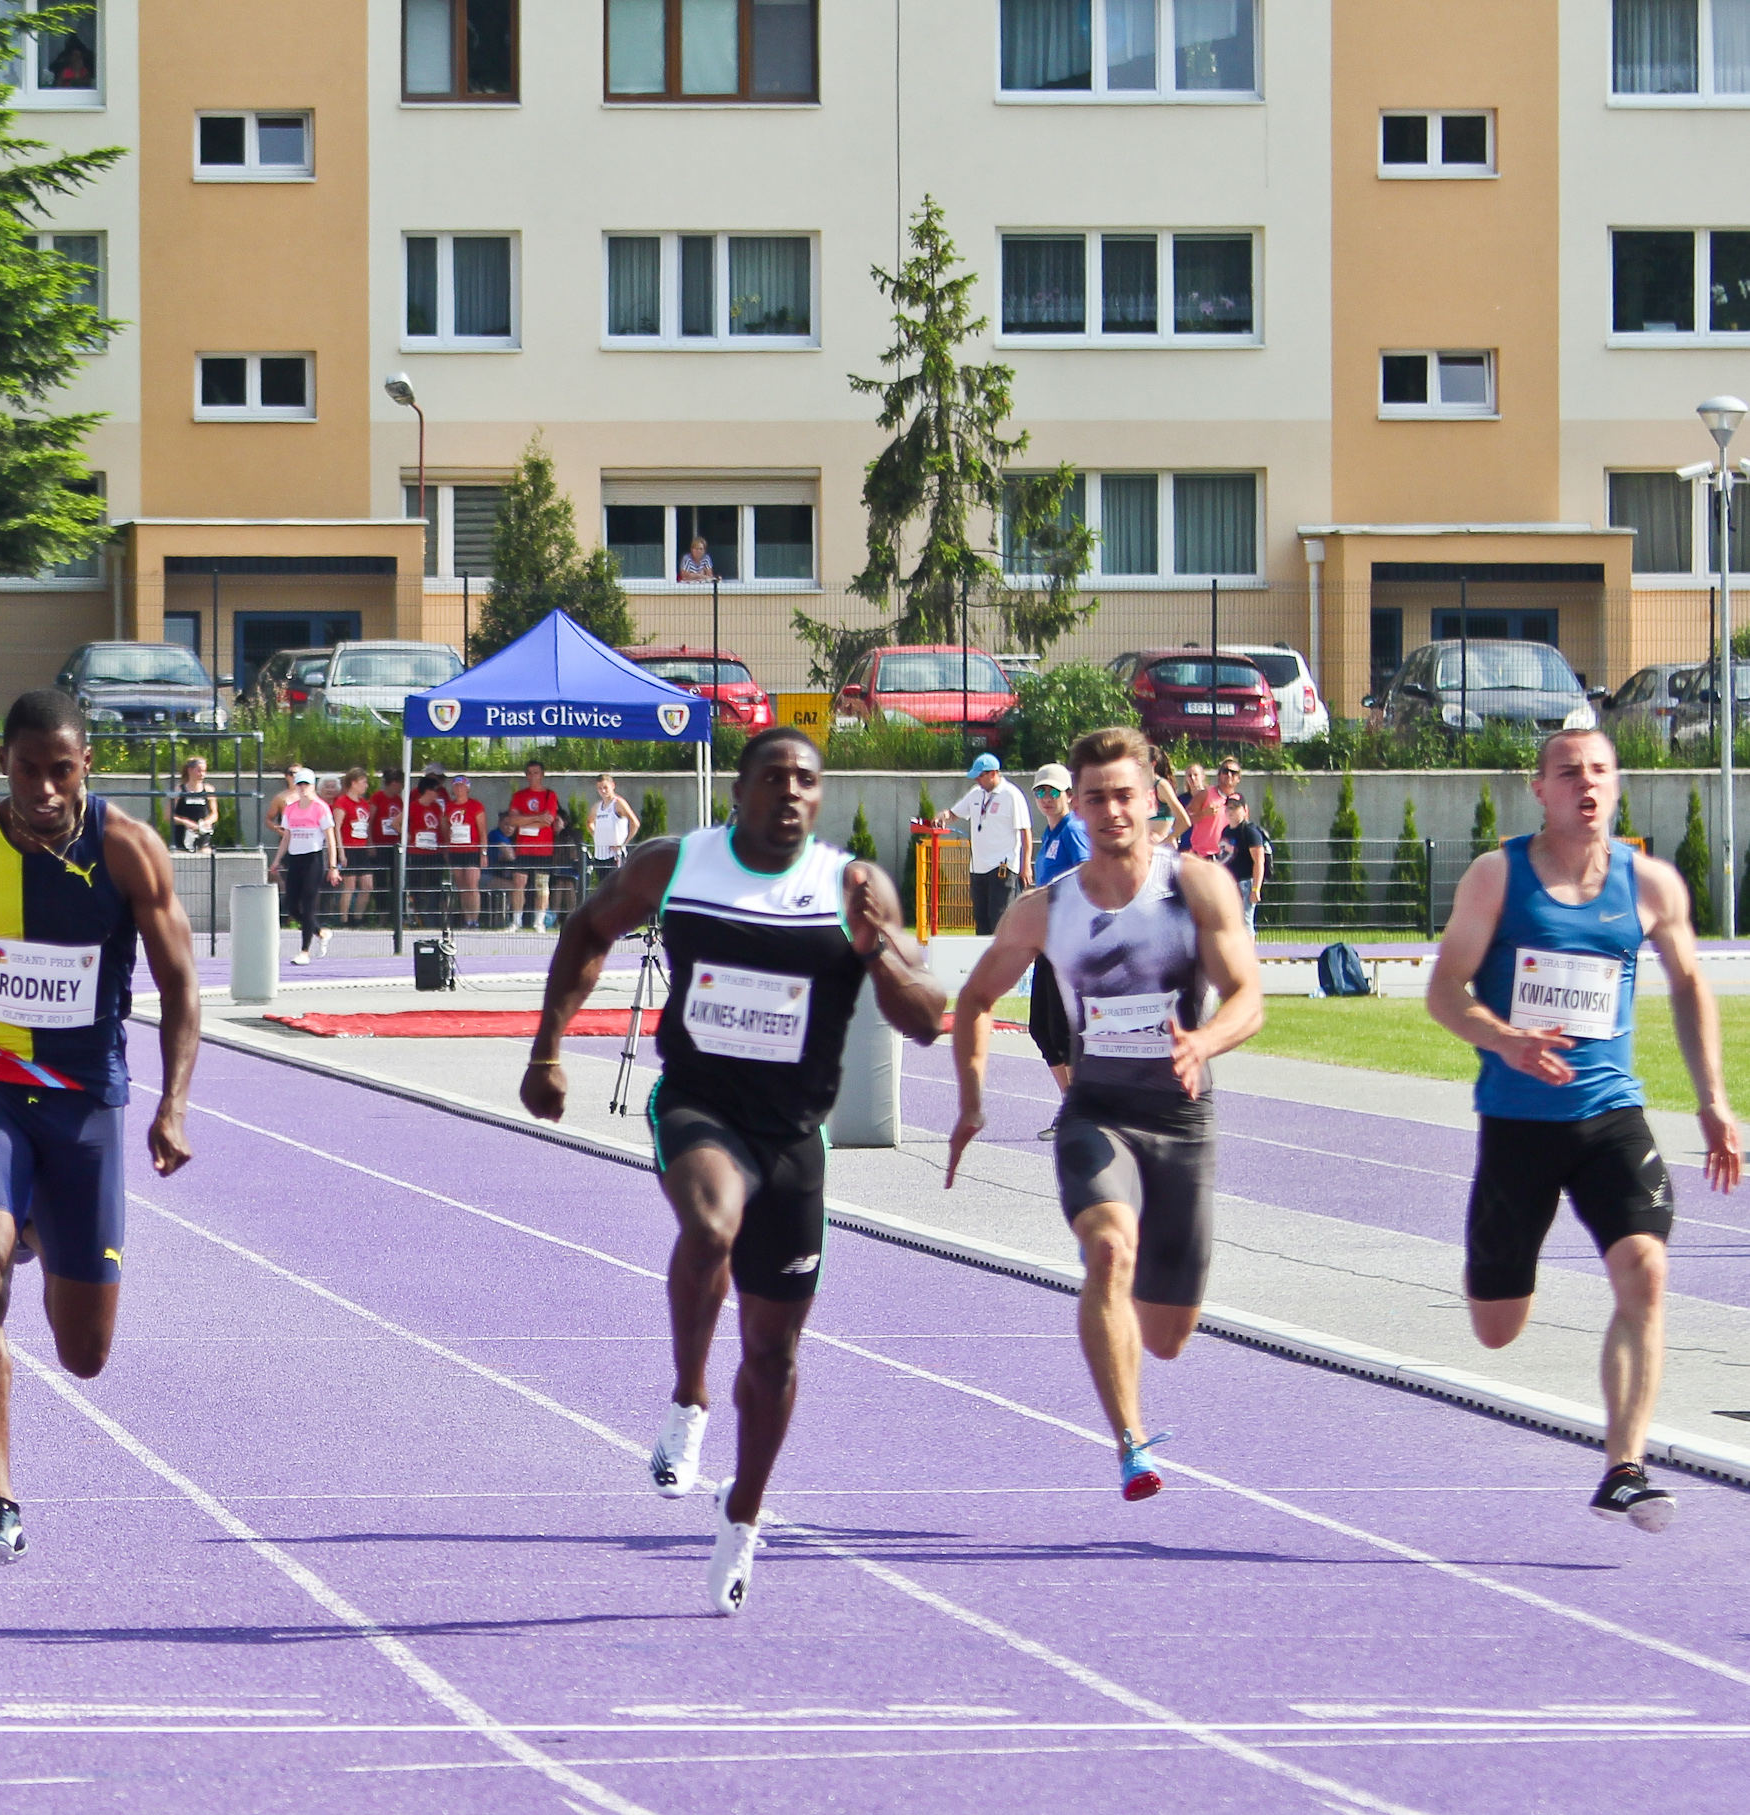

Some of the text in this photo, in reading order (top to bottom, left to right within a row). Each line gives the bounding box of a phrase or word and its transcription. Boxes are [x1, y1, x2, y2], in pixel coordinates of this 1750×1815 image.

[485, 706, 622, 728] Piast Gliwice
[793, 711, 818, 725] GAZ
[11, 953, 76, 968] GRAND PRIX
[1540, 958, 1599, 973] GRAND PRIX
[0, 973, 81, 1002] RODNEY
[1518, 982, 1610, 1013] KWIATKOWSKI
[2, 1010, 44, 1023] GLIWICE
[690, 1000, 801, 1036] AIKINES-ARYEETEY
[1102, 1005, 1161, 1017] GRAND PRIX
[1099, 1045, 1138, 1054] GLIWICE
